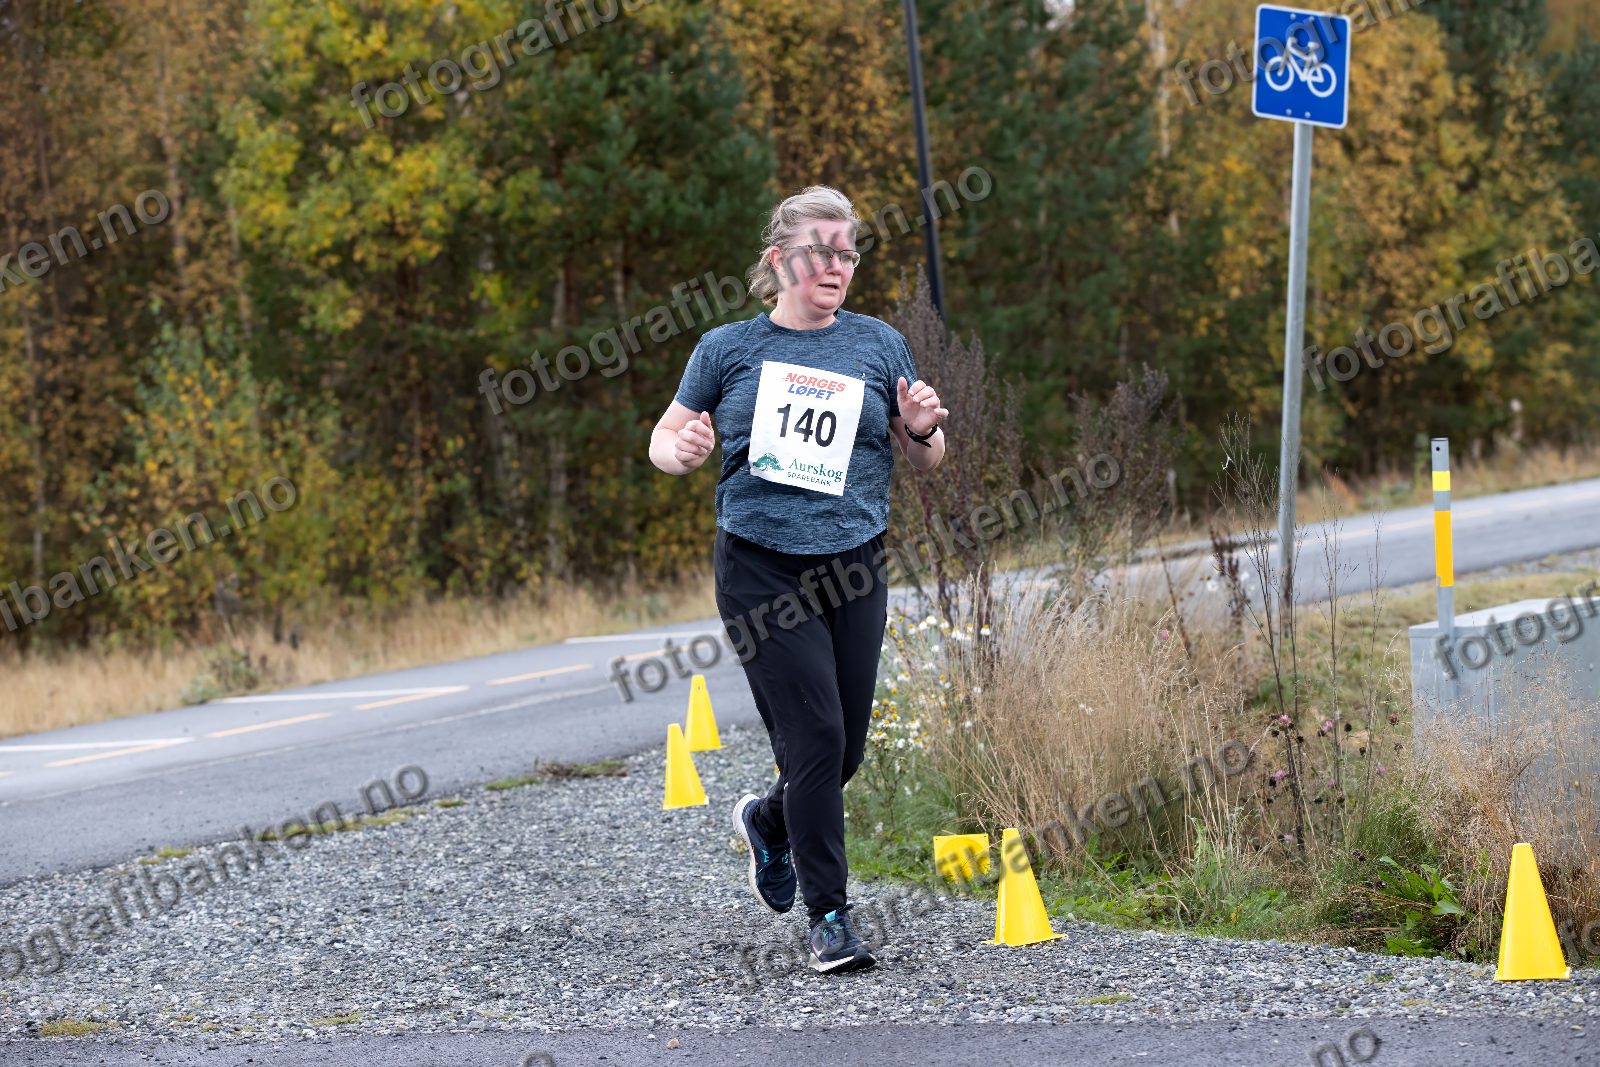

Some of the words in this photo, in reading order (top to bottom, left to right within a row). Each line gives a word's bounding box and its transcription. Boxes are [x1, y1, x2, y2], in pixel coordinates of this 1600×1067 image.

[786, 373, 846, 392] NORGES
[788, 384, 835, 400] LØPET
[777, 403, 837, 447] 140
[787, 471, 831, 486] SPAREBANK
[788, 458, 843, 482] Aurskog
